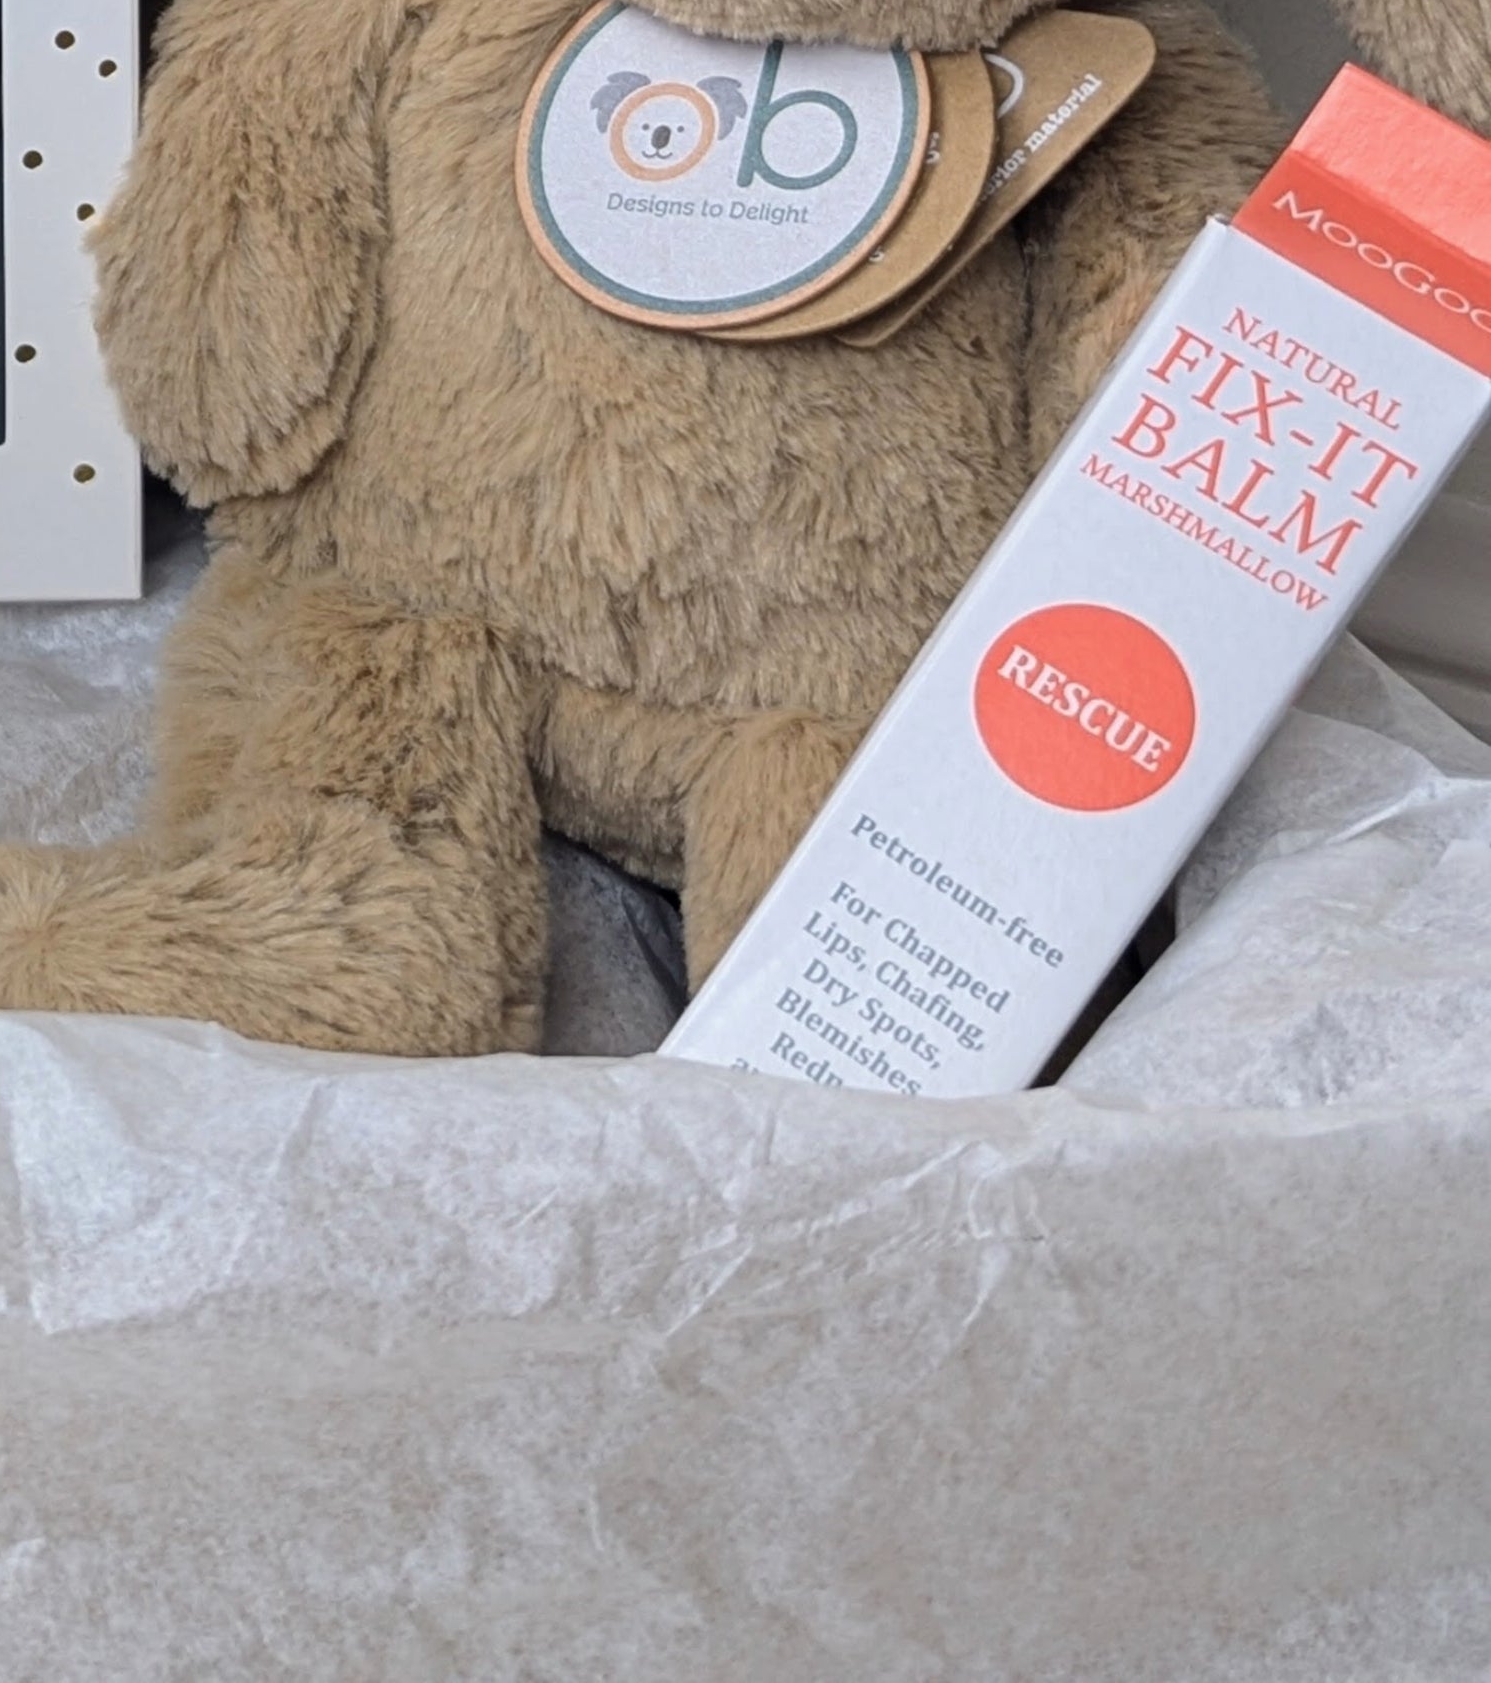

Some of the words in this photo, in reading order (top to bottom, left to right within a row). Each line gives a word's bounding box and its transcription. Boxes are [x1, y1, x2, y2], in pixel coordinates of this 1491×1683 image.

[606, 191, 695, 217] Designs
[701, 198, 724, 218] to
[729, 200, 809, 226] Delight
[1147, 326, 1419, 509] FIX-IT
[1222, 307, 1401, 431] NATURAL
[1079, 454, 1329, 612] MARSHMALLOW
[1112, 394, 1363, 577] BALM
[996, 643, 1172, 772] RESCUE
[829, 880, 882, 926] For
[883, 917, 1011, 1014] Chapped
[850, 813, 1065, 969] Petroleum-free
[775, 986, 923, 1096] Blemishes
[802, 911, 868, 972] Lips,
[874, 959, 987, 1052] Chafing,
[802, 958, 860, 1008] Dry
[858, 996, 942, 1070] Spots,
